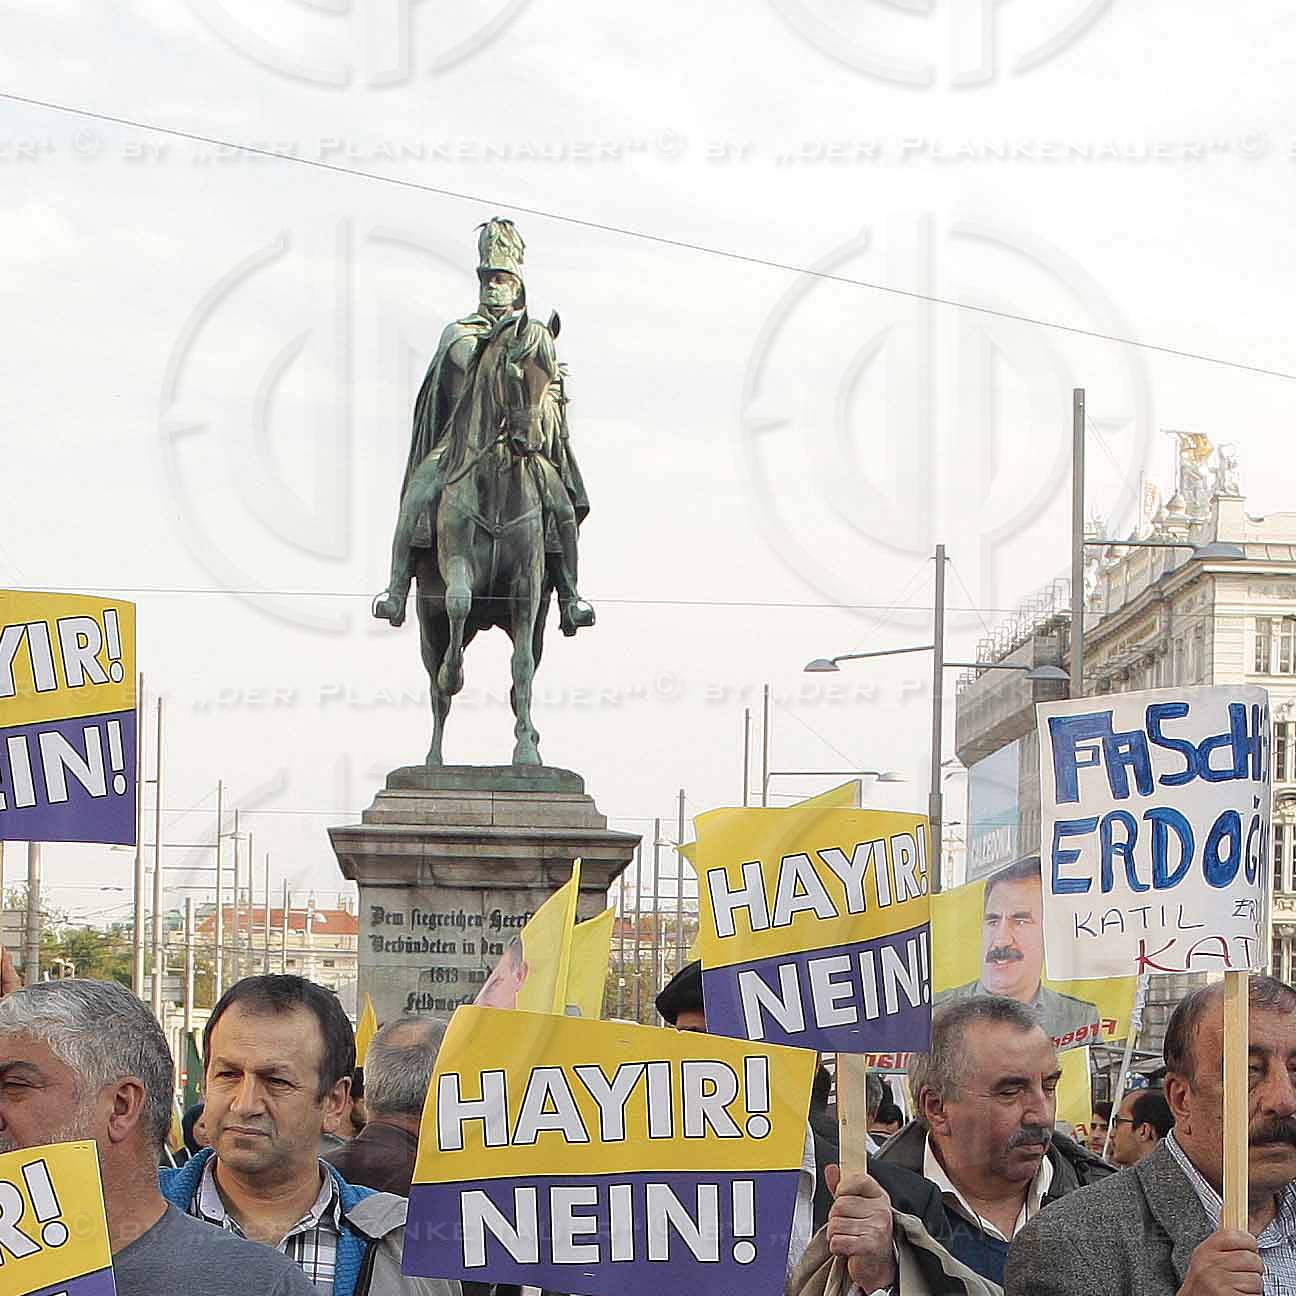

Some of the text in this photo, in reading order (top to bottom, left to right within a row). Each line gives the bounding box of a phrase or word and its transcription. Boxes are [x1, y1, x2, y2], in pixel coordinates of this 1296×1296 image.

[706, 824, 929, 938] HAYIR!
[737, 931, 931, 1042] NEIN!
[437, 1055, 772, 1152] HAYIR!
[460, 1178, 759, 1270] NEIN!
